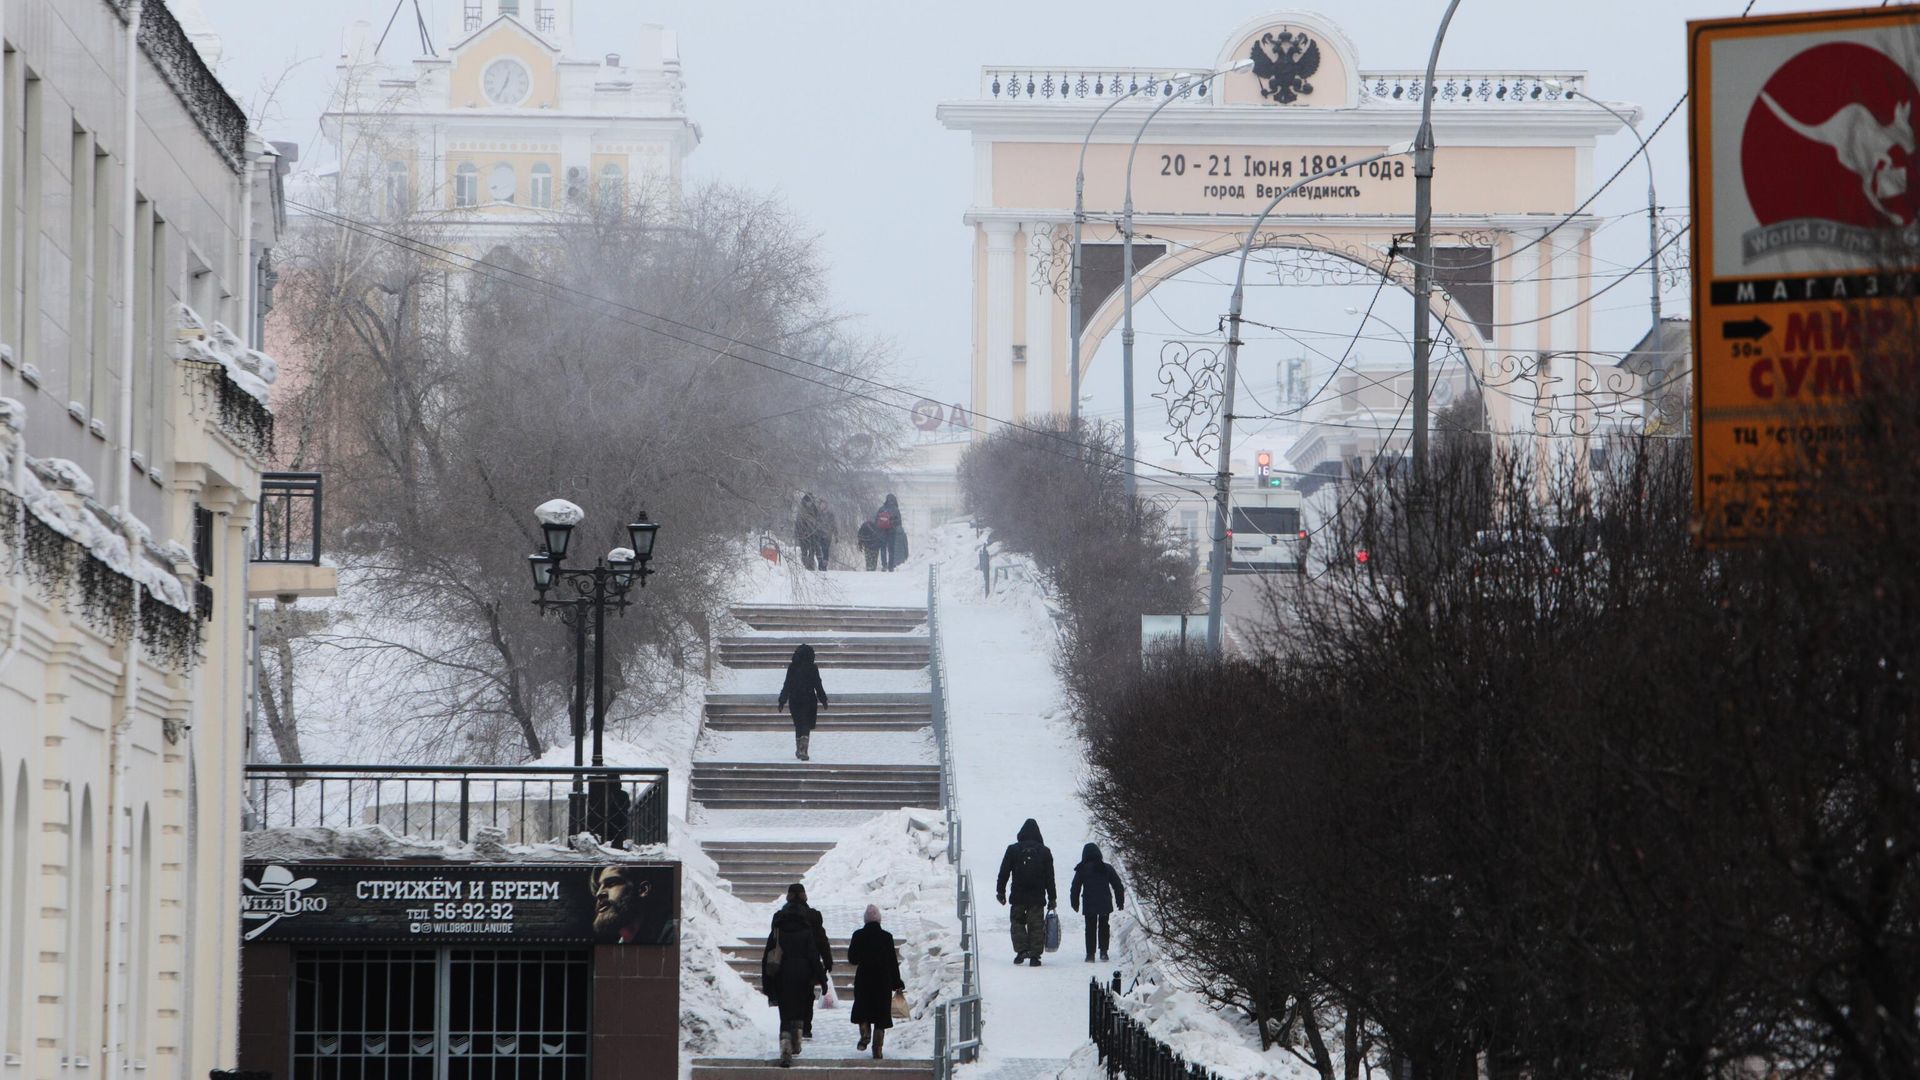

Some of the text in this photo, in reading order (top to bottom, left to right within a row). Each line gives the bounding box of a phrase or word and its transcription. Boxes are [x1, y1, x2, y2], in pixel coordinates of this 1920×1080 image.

[1299, 154, 1349, 178] 1891
[1359, 159, 1405, 181] года
[1203, 183, 1361, 200] город Верхнеудинскъ
[1751, 222, 1810, 250] World
[1817, 225, 1837, 242] of
[1258, 465, 1270, 476] 16
[356, 876, 560, 900] СТРИЖЁМ И БРЕЕМ
[433, 902, 514, 920] 56-92-92
[433, 922, 514, 934] WILDBRO.ULANUDE
